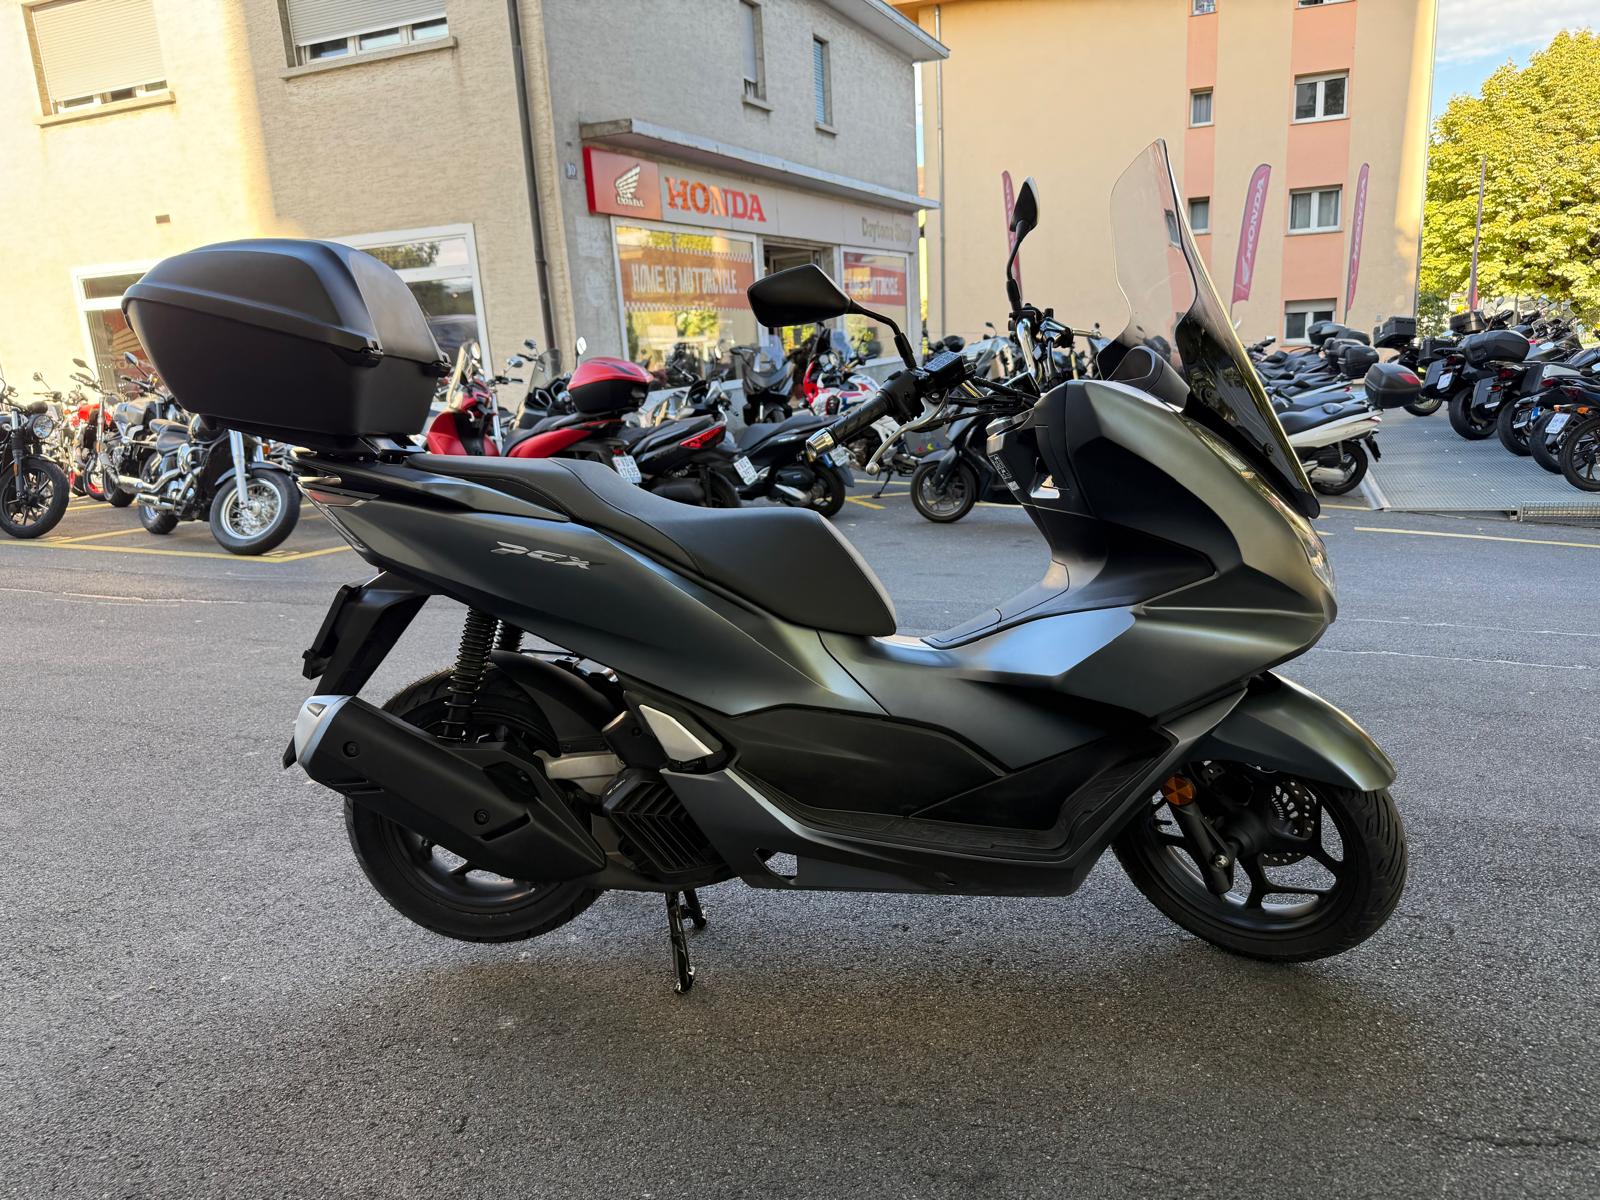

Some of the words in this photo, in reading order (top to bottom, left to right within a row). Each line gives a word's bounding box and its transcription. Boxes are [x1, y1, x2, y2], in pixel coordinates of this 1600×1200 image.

[664, 176, 768, 223] HONDA
[1247, 176, 1266, 261] HONDA
[631, 263, 664, 294] HOME
[664, 264, 677, 294] OF
[490, 540, 591, 570] PCX
